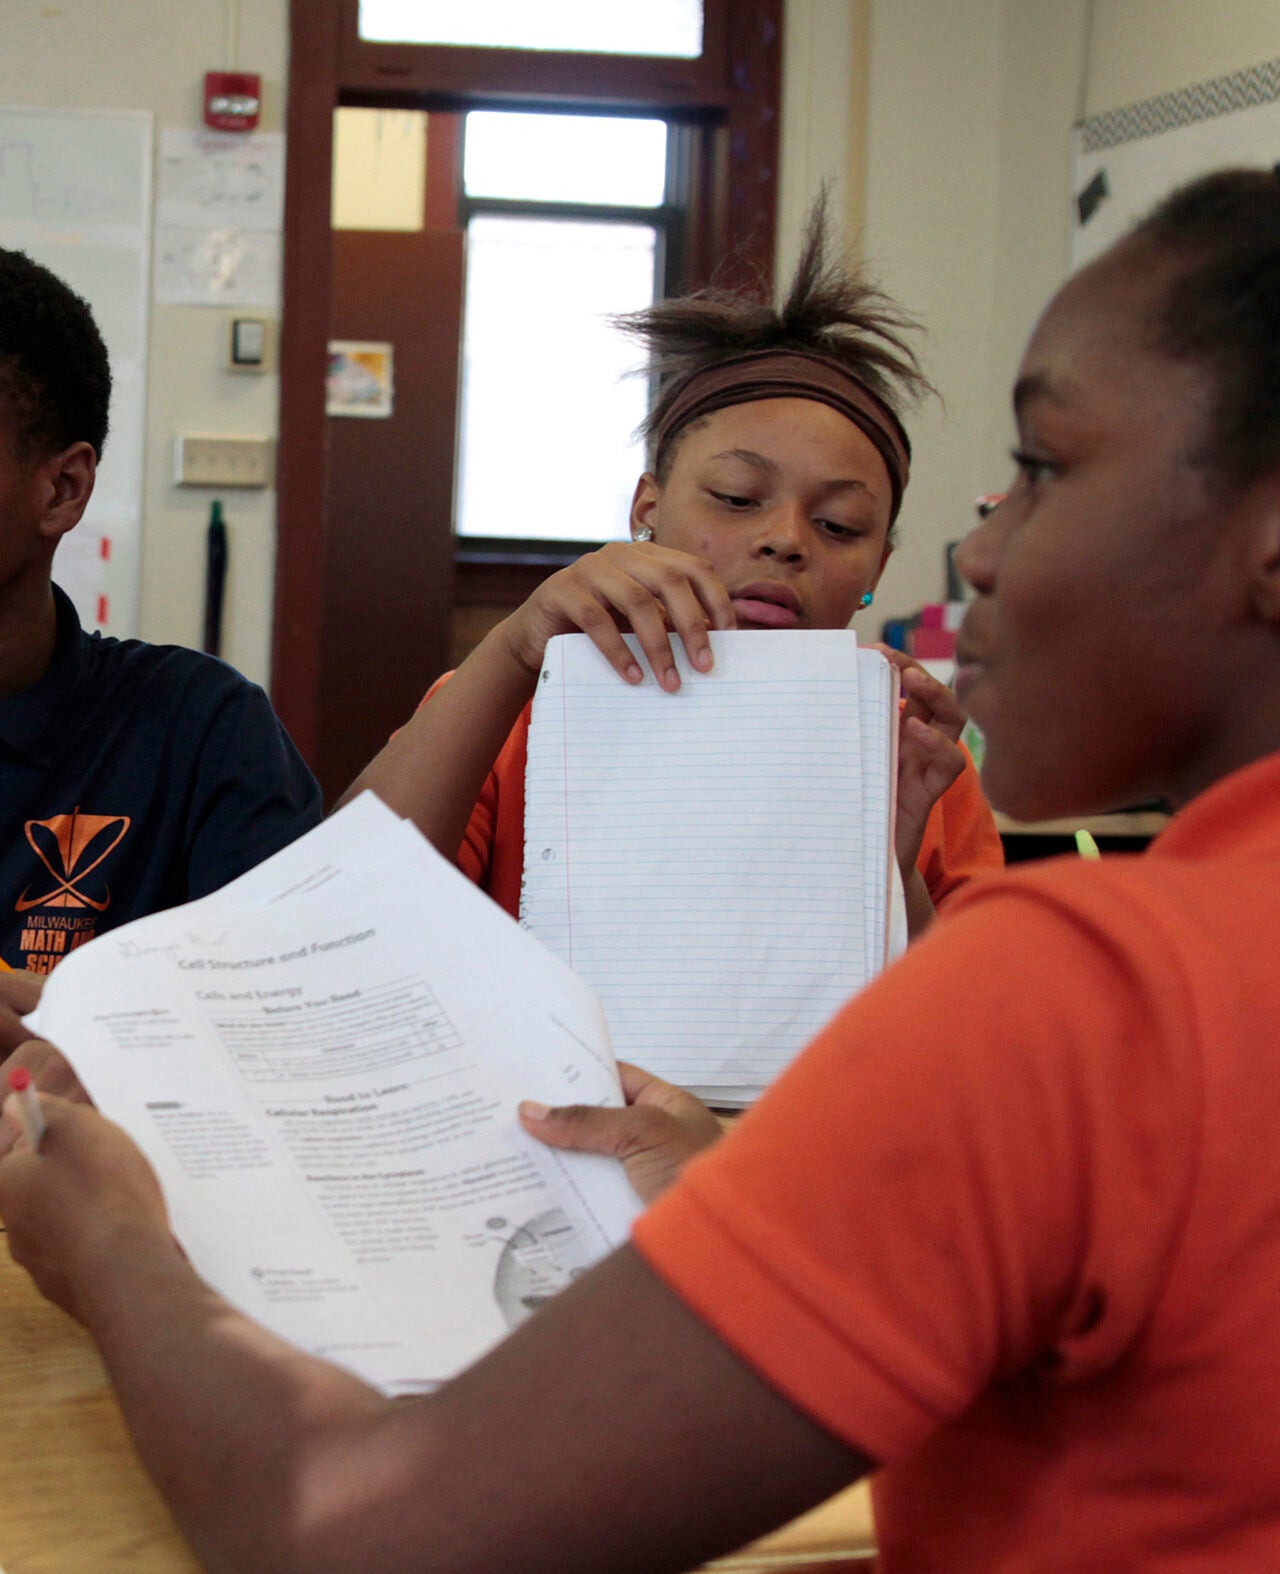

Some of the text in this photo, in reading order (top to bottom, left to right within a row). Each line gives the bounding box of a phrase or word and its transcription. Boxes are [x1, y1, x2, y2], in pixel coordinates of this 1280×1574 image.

[19, 929, 67, 953] MATH
[177, 928, 376, 970] Cell Structure and Function
[228, 989, 254, 1000] and
[254, 986, 303, 1001] Energy
